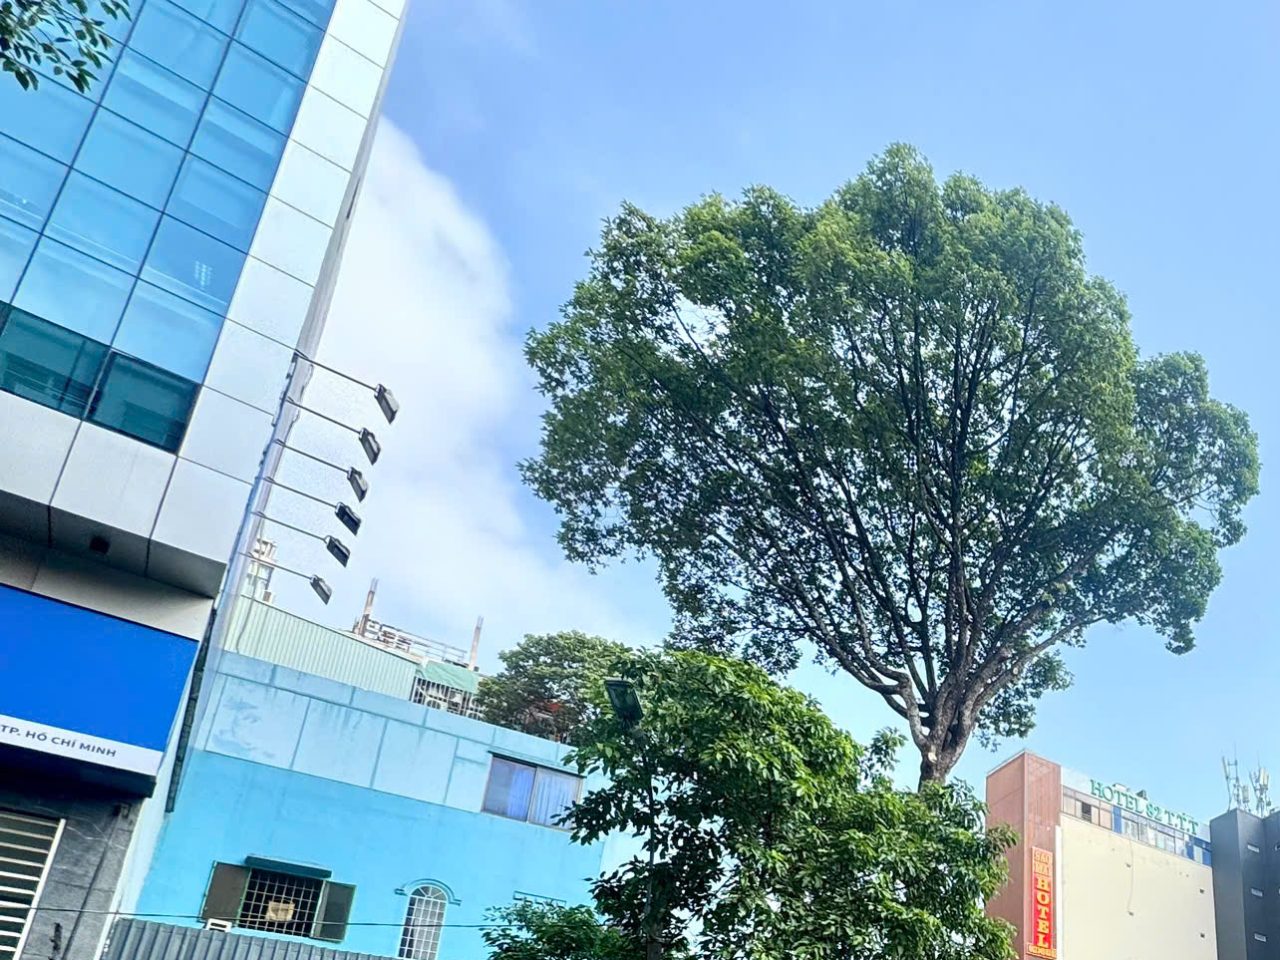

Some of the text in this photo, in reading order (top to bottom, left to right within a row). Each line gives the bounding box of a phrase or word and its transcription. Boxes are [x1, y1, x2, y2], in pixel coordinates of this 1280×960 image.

[0, 724, 21, 736] TP.
[51, 736, 77, 749] CHÍ
[79, 742, 117, 757] MINH
[1090, 779, 1144, 814] HOTEL
[1036, 875, 1051, 949] HOTEL
